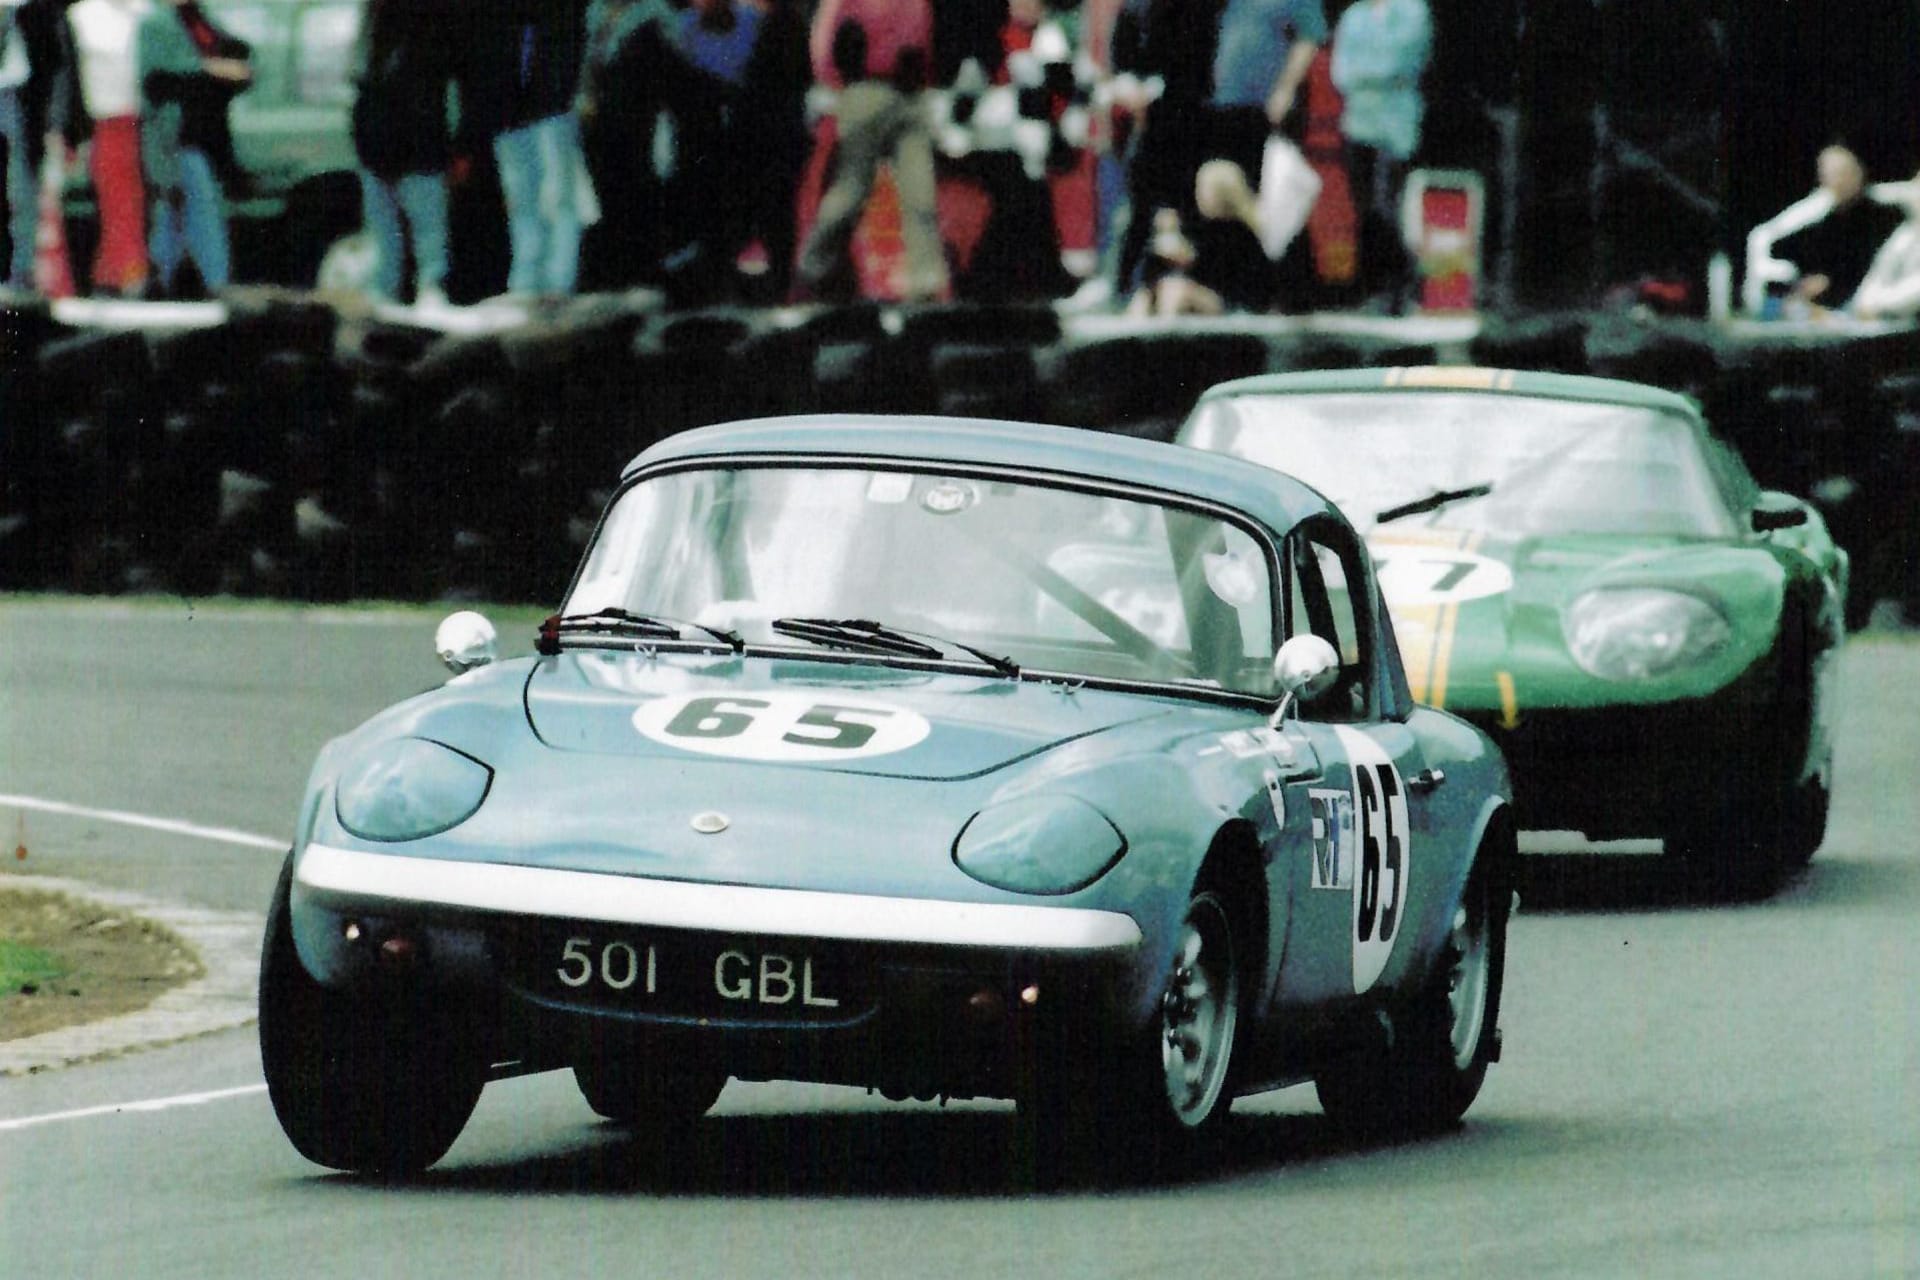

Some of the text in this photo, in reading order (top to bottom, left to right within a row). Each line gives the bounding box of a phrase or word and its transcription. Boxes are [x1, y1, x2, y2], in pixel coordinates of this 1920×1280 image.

[664, 697, 893, 749] 65
[1356, 764, 1400, 942] 65
[557, 937, 839, 1007] 501 GBL
